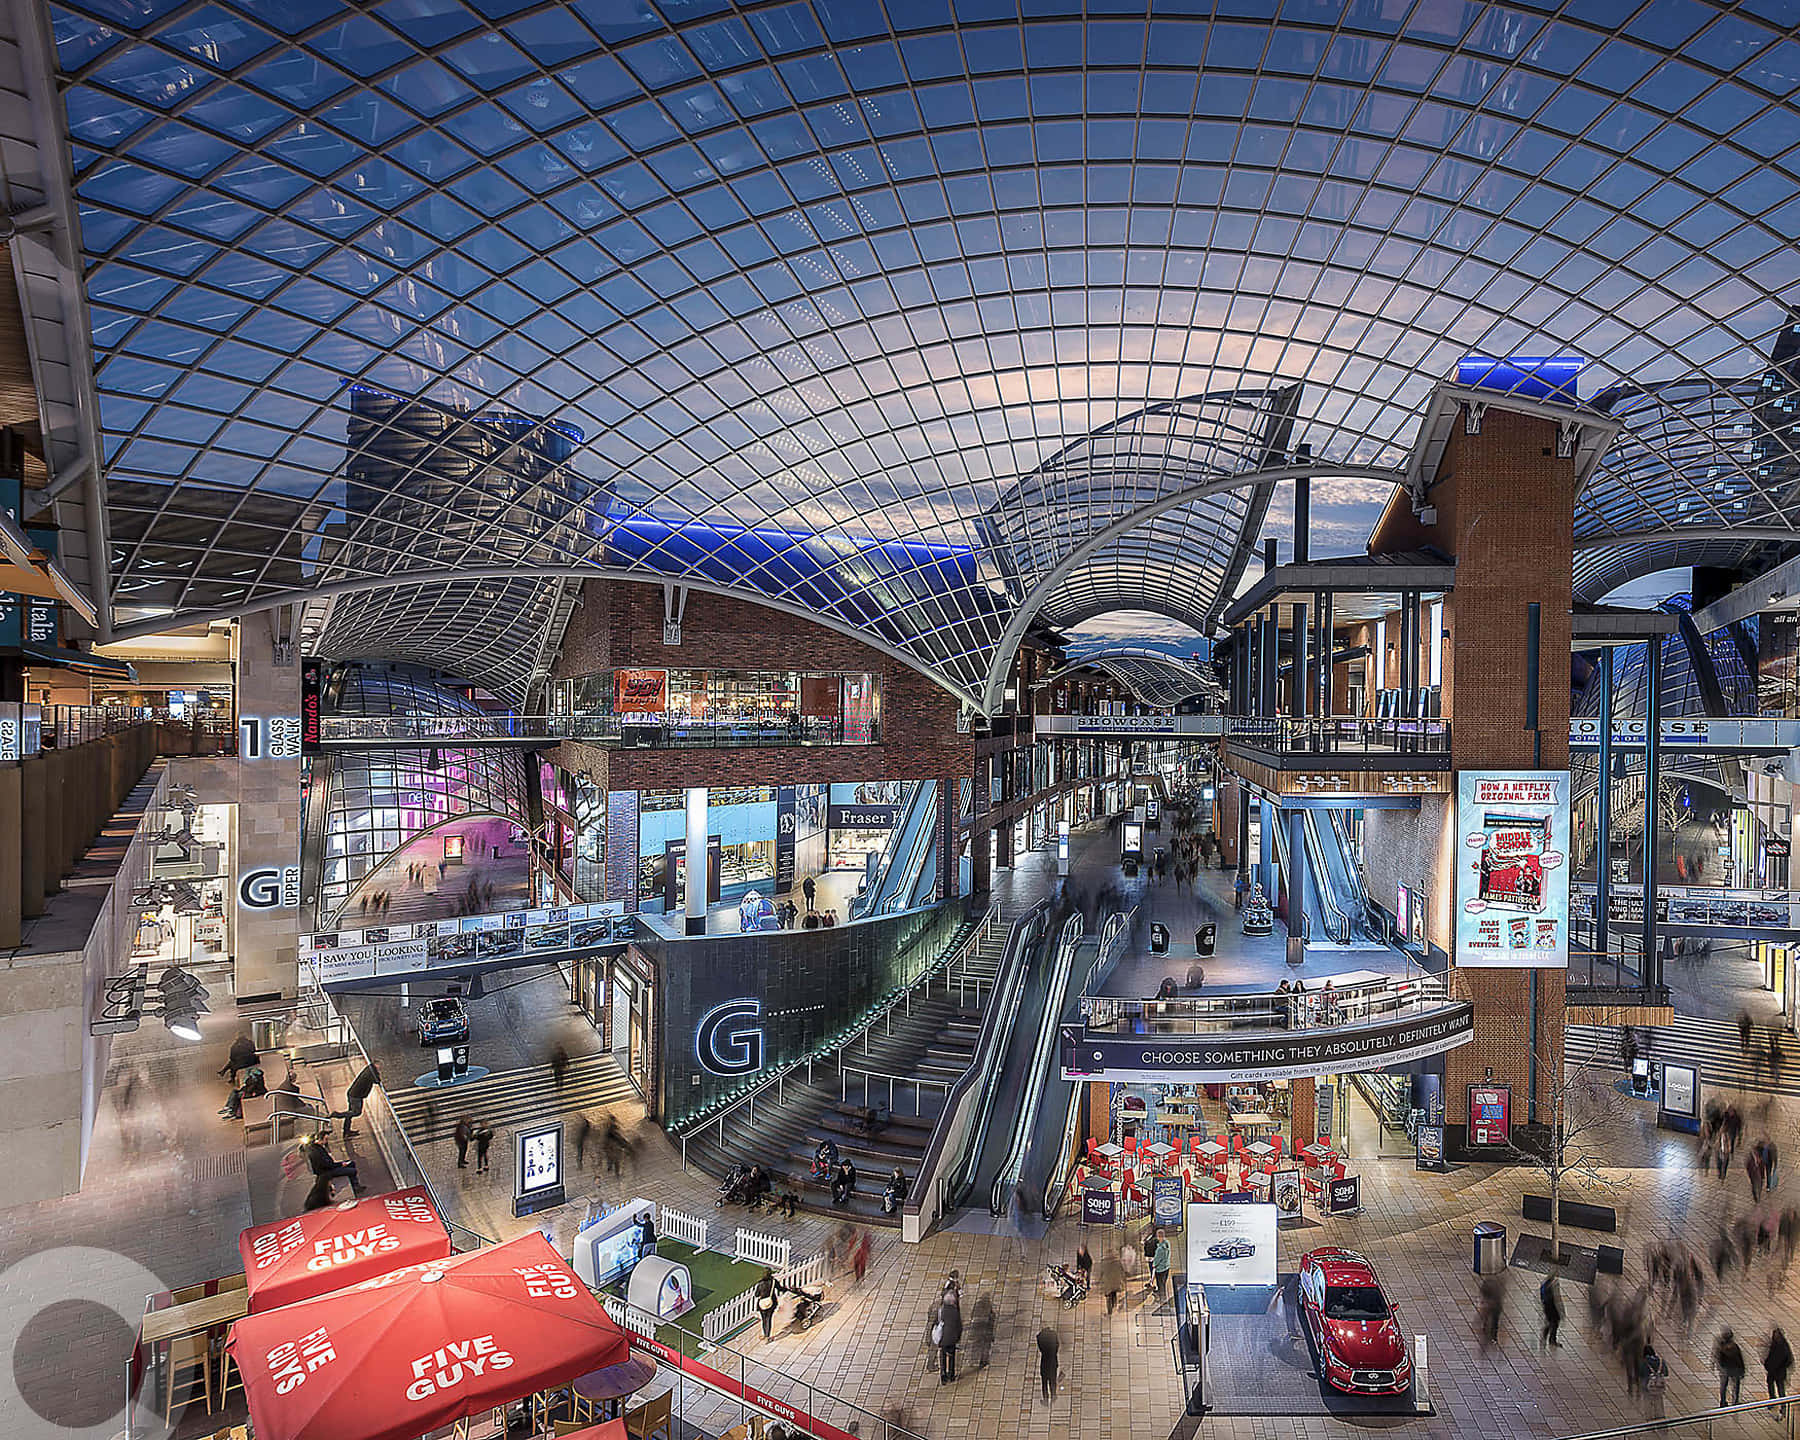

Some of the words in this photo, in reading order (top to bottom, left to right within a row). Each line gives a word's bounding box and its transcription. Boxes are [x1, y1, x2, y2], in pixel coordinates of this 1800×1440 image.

[31, 599, 55, 642] Italia
[303, 693, 318, 744] Nando's
[1078, 718, 1175, 726] SHOWCASE
[241, 719, 259, 757] 1
[271, 719, 283, 756] GLASS
[286, 719, 299, 756] WALK
[408, 791, 434, 803] next
[1481, 783, 1500, 791] NOW
[1503, 783, 1509, 791] A
[1513, 783, 1551, 791] NETFLIX
[1481, 792, 1525, 800] ORIGINAL
[1528, 792, 1550, 800] FILM
[840, 810, 886, 824] Fraser
[1496, 832, 1531, 841] MIDDLE
[1496, 840, 1533, 850] SCHOOL
[240, 870, 280, 908] G
[284, 868, 299, 905] UPPER
[1482, 892, 1502, 901] JAMES
[1503, 893, 1538, 905] PATTERSON
[323, 952, 348, 964] SAW
[350, 951, 371, 961] YOU
[696, 1000, 762, 1077] G
[1141, 1051, 1200, 1064] CHOOSE
[1204, 1048, 1285, 1064] SOMETHING
[1289, 1045, 1321, 1059] THEY
[1399, 1022, 1448, 1044] DEFINITELY
[1448, 1015, 1470, 1030] WANT
[1264, 1069, 1292, 1077] available
[1087, 1198, 1111, 1209] SOHO
[1334, 1185, 1354, 1197] SOHO
[384, 1198, 411, 1222] FIVE
[405, 1196, 434, 1223] GUYS
[253, 1232, 282, 1269] GUYS
[279, 1221, 306, 1253] FIVE
[314, 1224, 388, 1255] FIVE
[307, 1236, 400, 1271] GUYS
[512, 1267, 552, 1297] FIVE
[534, 1264, 577, 1298] GUYS
[298, 1326, 337, 1373] FIVE
[411, 1335, 498, 1379] FIVE
[636, 1337, 650, 1350] FIVE
[651, 1344, 669, 1358] GUYS
[266, 1342, 306, 1395] GUYS
[406, 1351, 514, 1401] GUYS
[757, 1395, 773, 1410] FIVE
[775, 1404, 795, 1420] GUYS
